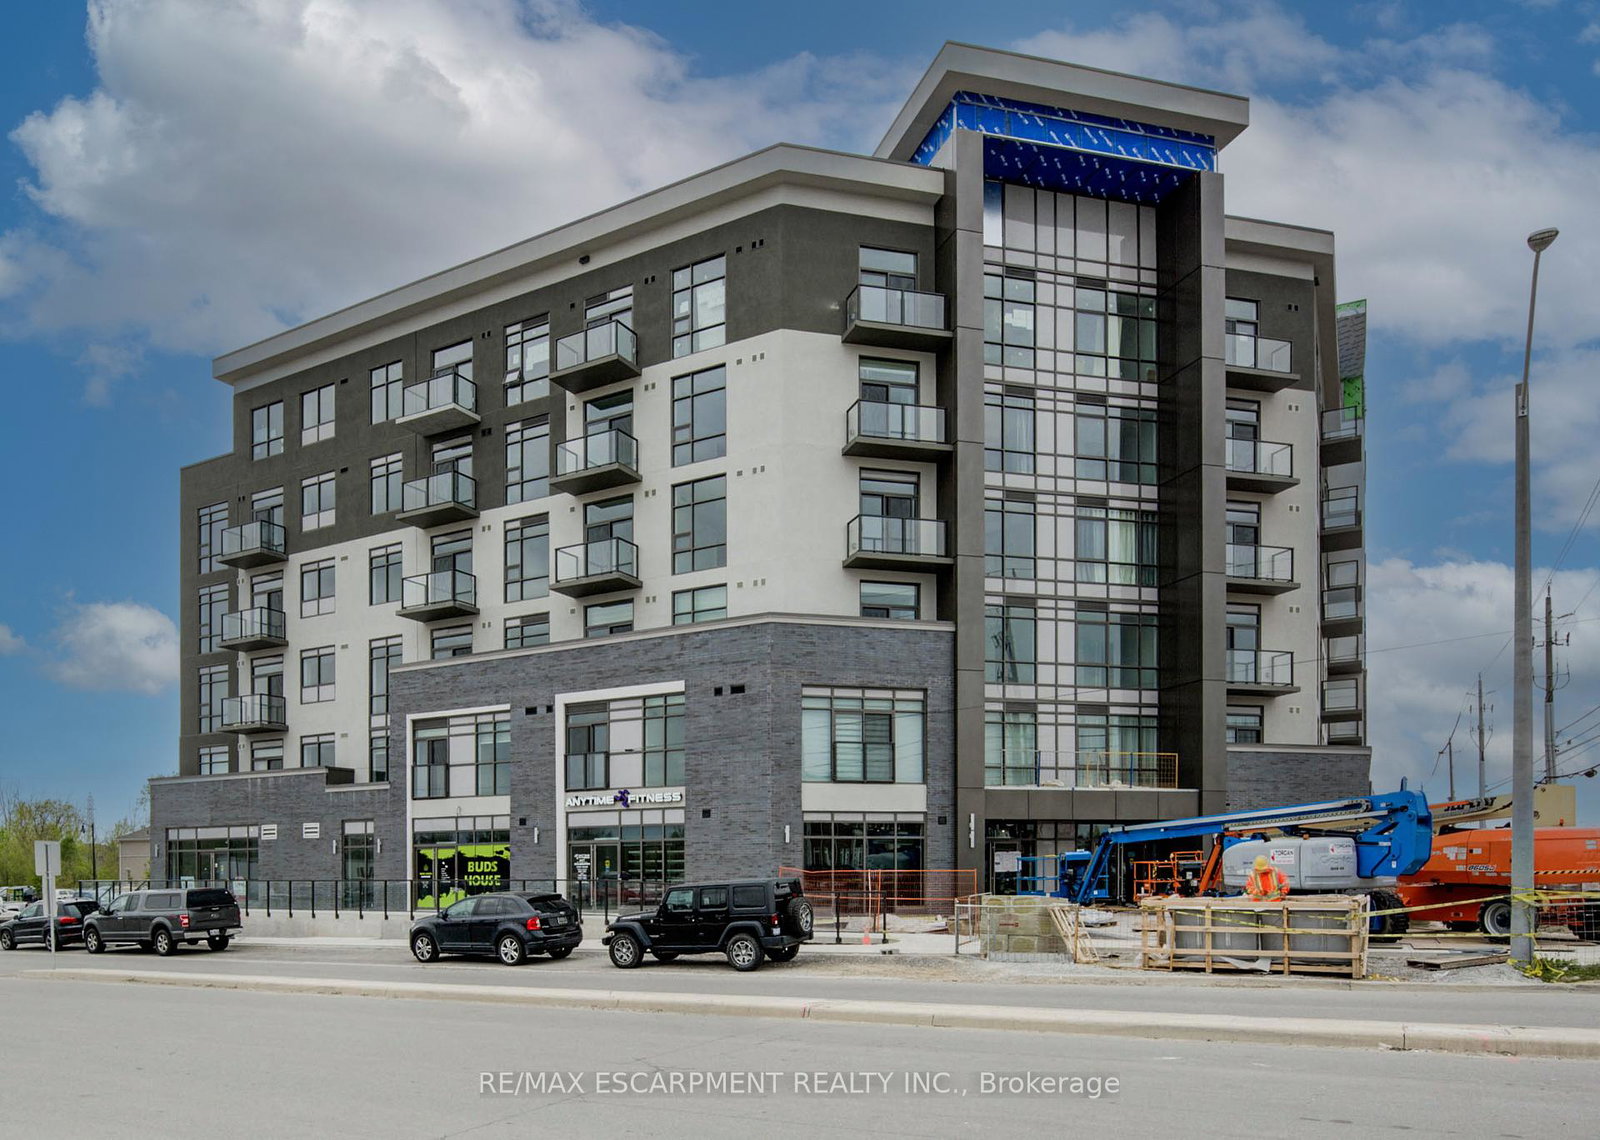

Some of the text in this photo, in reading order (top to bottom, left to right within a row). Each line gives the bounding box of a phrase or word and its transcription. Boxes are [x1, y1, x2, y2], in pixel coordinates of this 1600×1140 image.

[566, 791, 682, 807] ANYTIME FITNESS
[467, 861, 498, 872] BUDS
[464, 874, 501, 886] HOUSE
